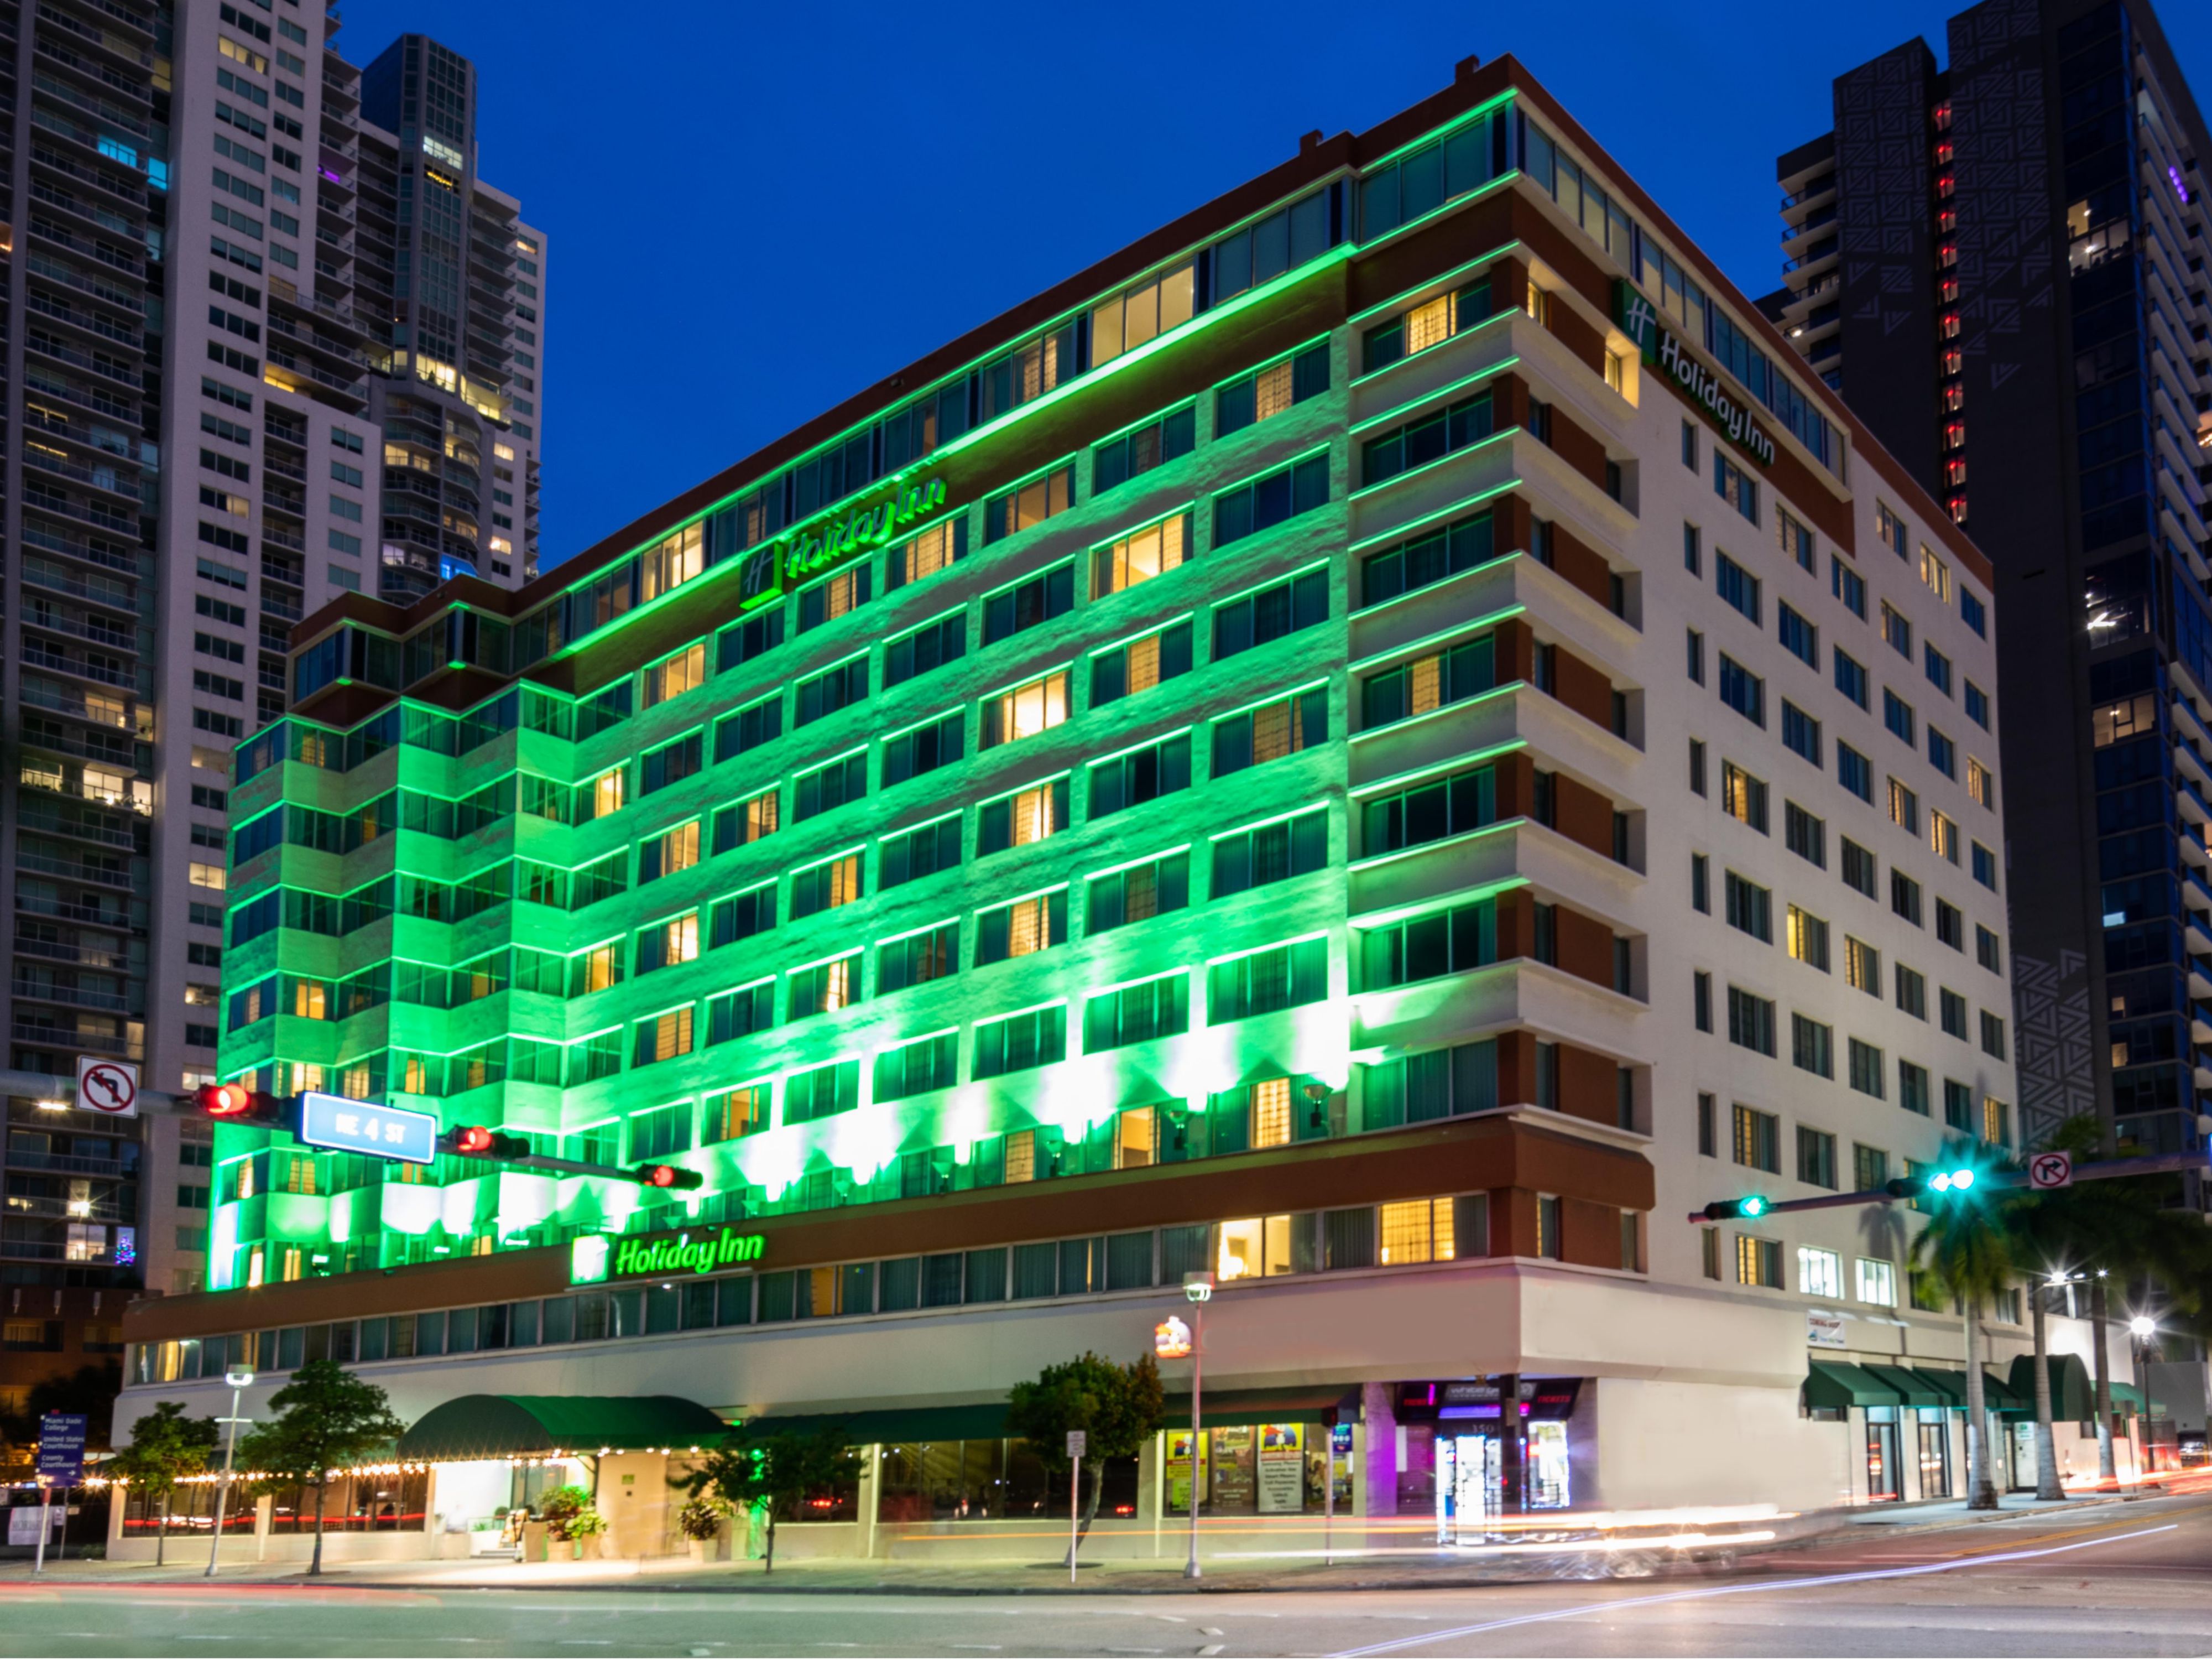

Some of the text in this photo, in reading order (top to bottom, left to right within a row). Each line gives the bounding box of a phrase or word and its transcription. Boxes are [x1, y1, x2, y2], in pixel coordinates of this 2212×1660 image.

[1661, 331, 1775, 465] Holiday Inn
[784, 478, 947, 579] Holiday Inn
[336, 1113, 406, 1144] NE 4 ST
[615, 1227, 766, 1274] Holiday Inn
[1537, 1394, 1572, 1403] TICKETS
